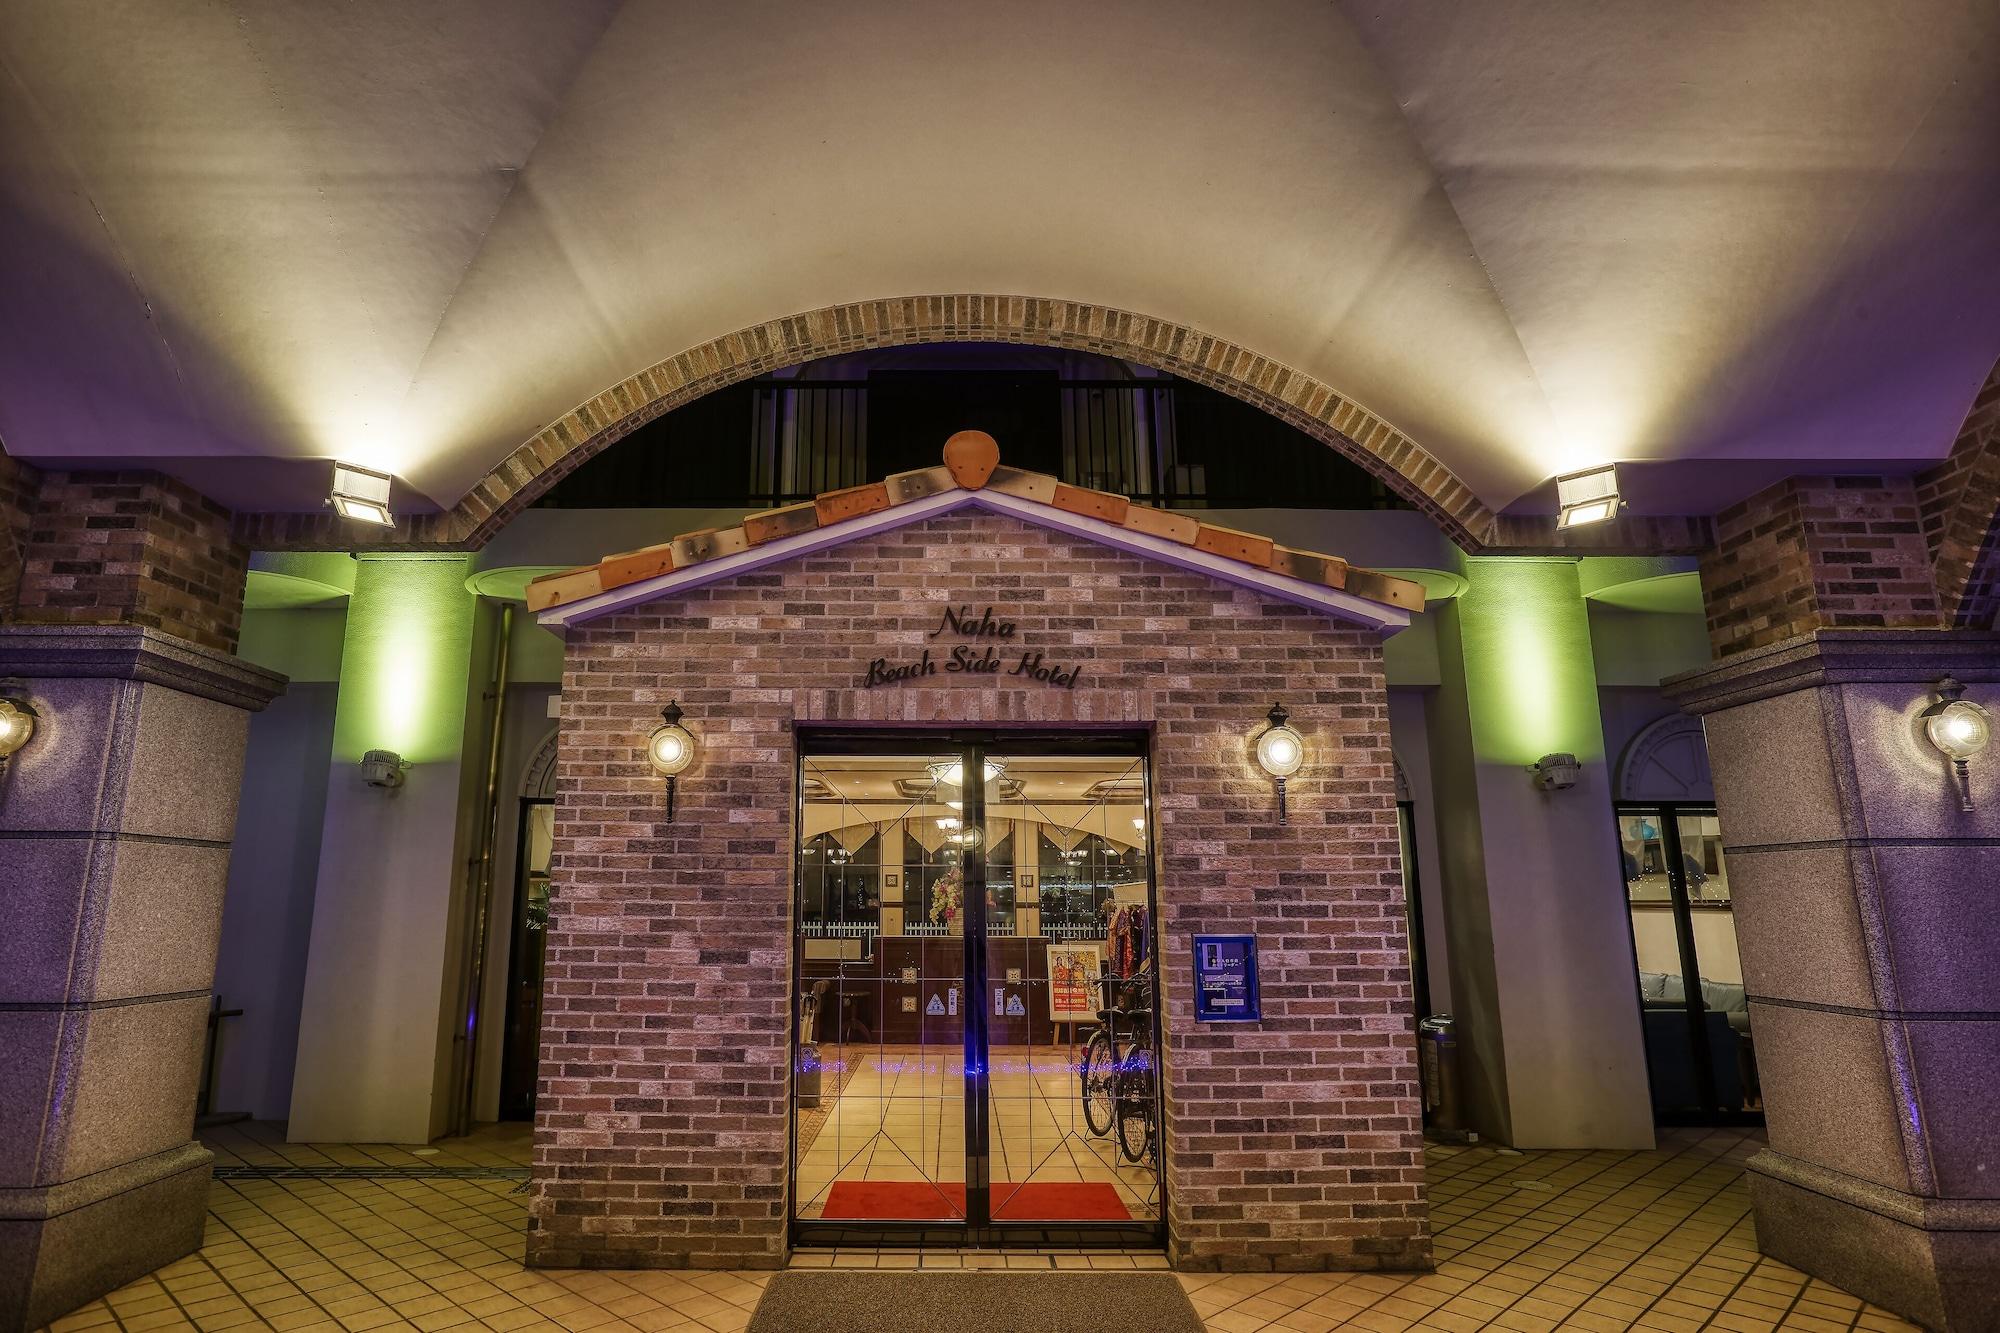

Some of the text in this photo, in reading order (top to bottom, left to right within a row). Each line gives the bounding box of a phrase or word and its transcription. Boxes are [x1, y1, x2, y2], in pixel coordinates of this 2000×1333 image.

[929, 605, 1017, 639] Naha
[863, 645, 1082, 690] Beach Side Hotel
